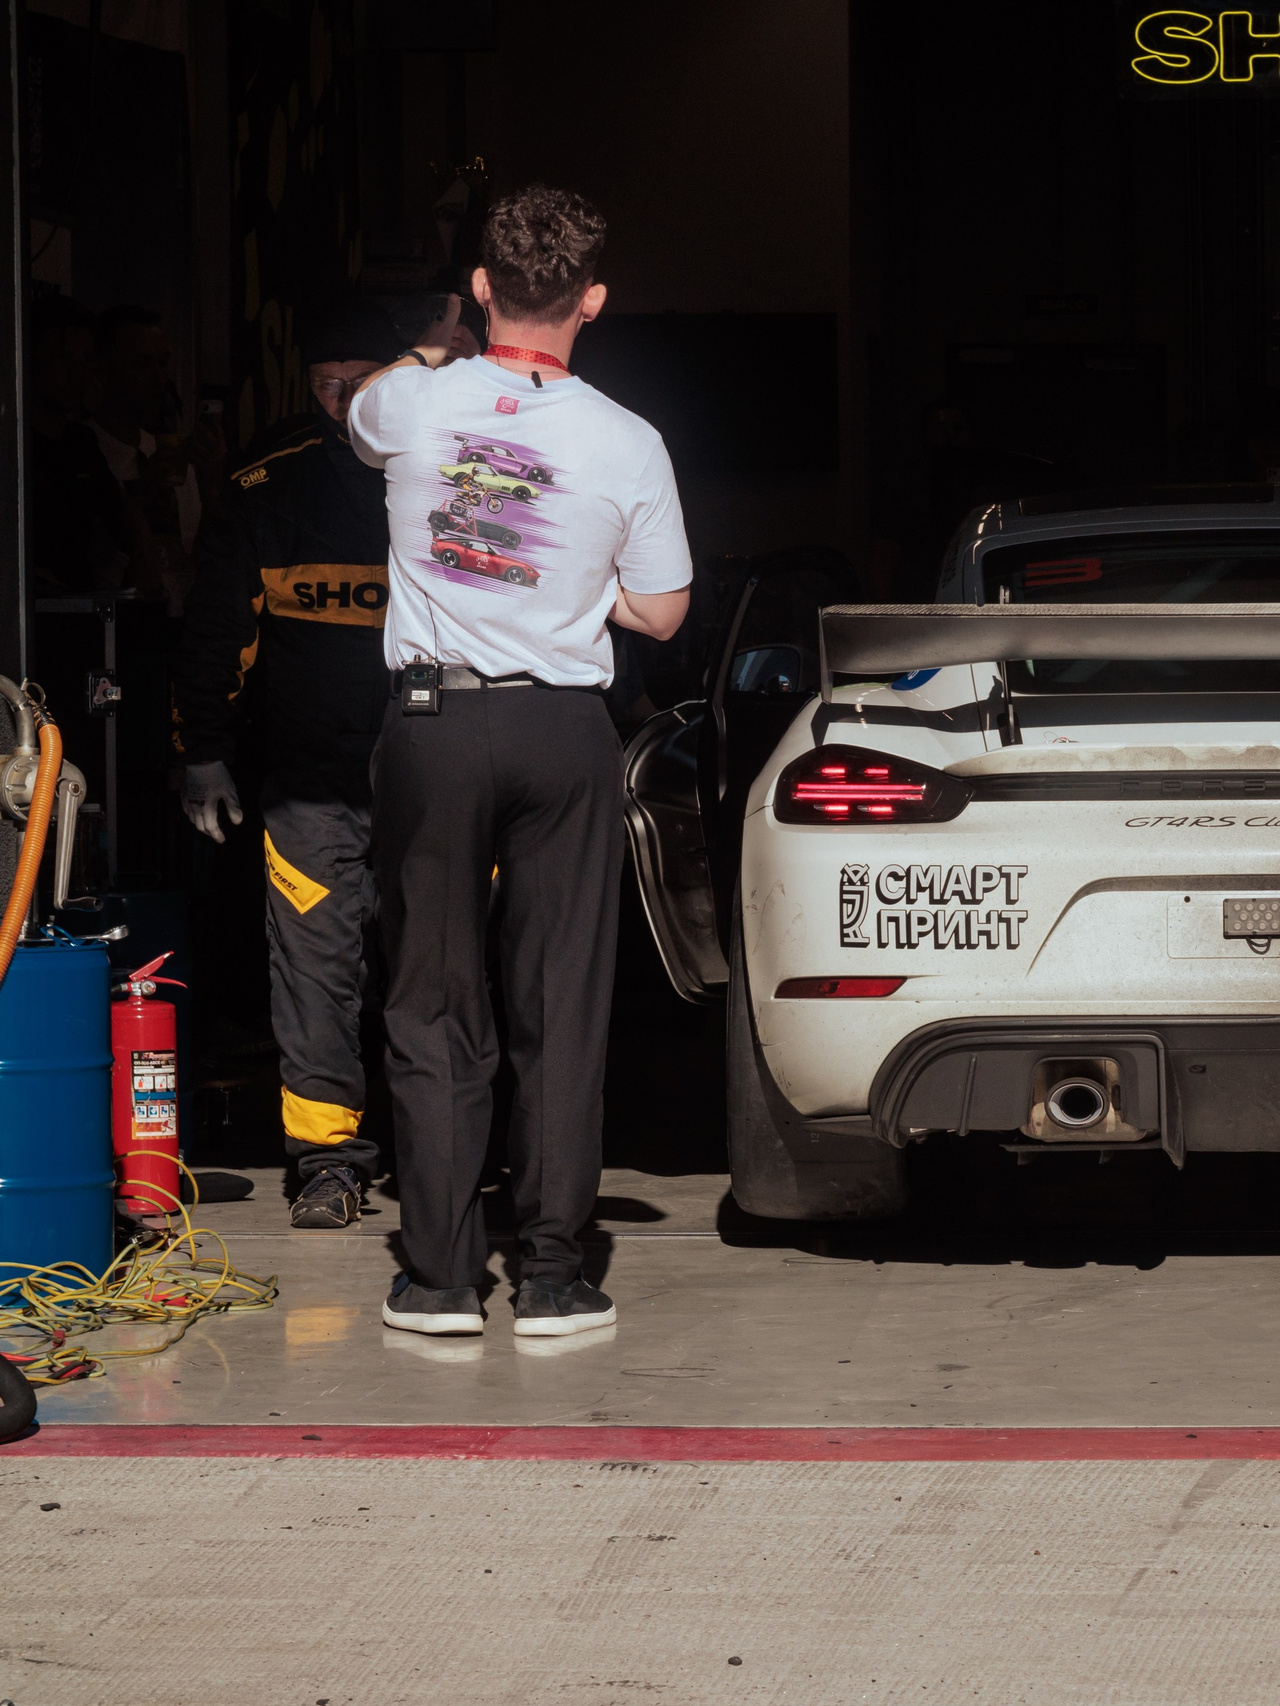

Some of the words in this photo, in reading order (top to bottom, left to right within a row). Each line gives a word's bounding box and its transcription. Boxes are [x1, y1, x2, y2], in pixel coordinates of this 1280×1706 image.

[240, 468, 268, 487] OMP
[274, 871, 298, 891] FIRST
[875, 864, 1028, 905] СМАРТ
[876, 908, 1028, 950] ПРИНТ
